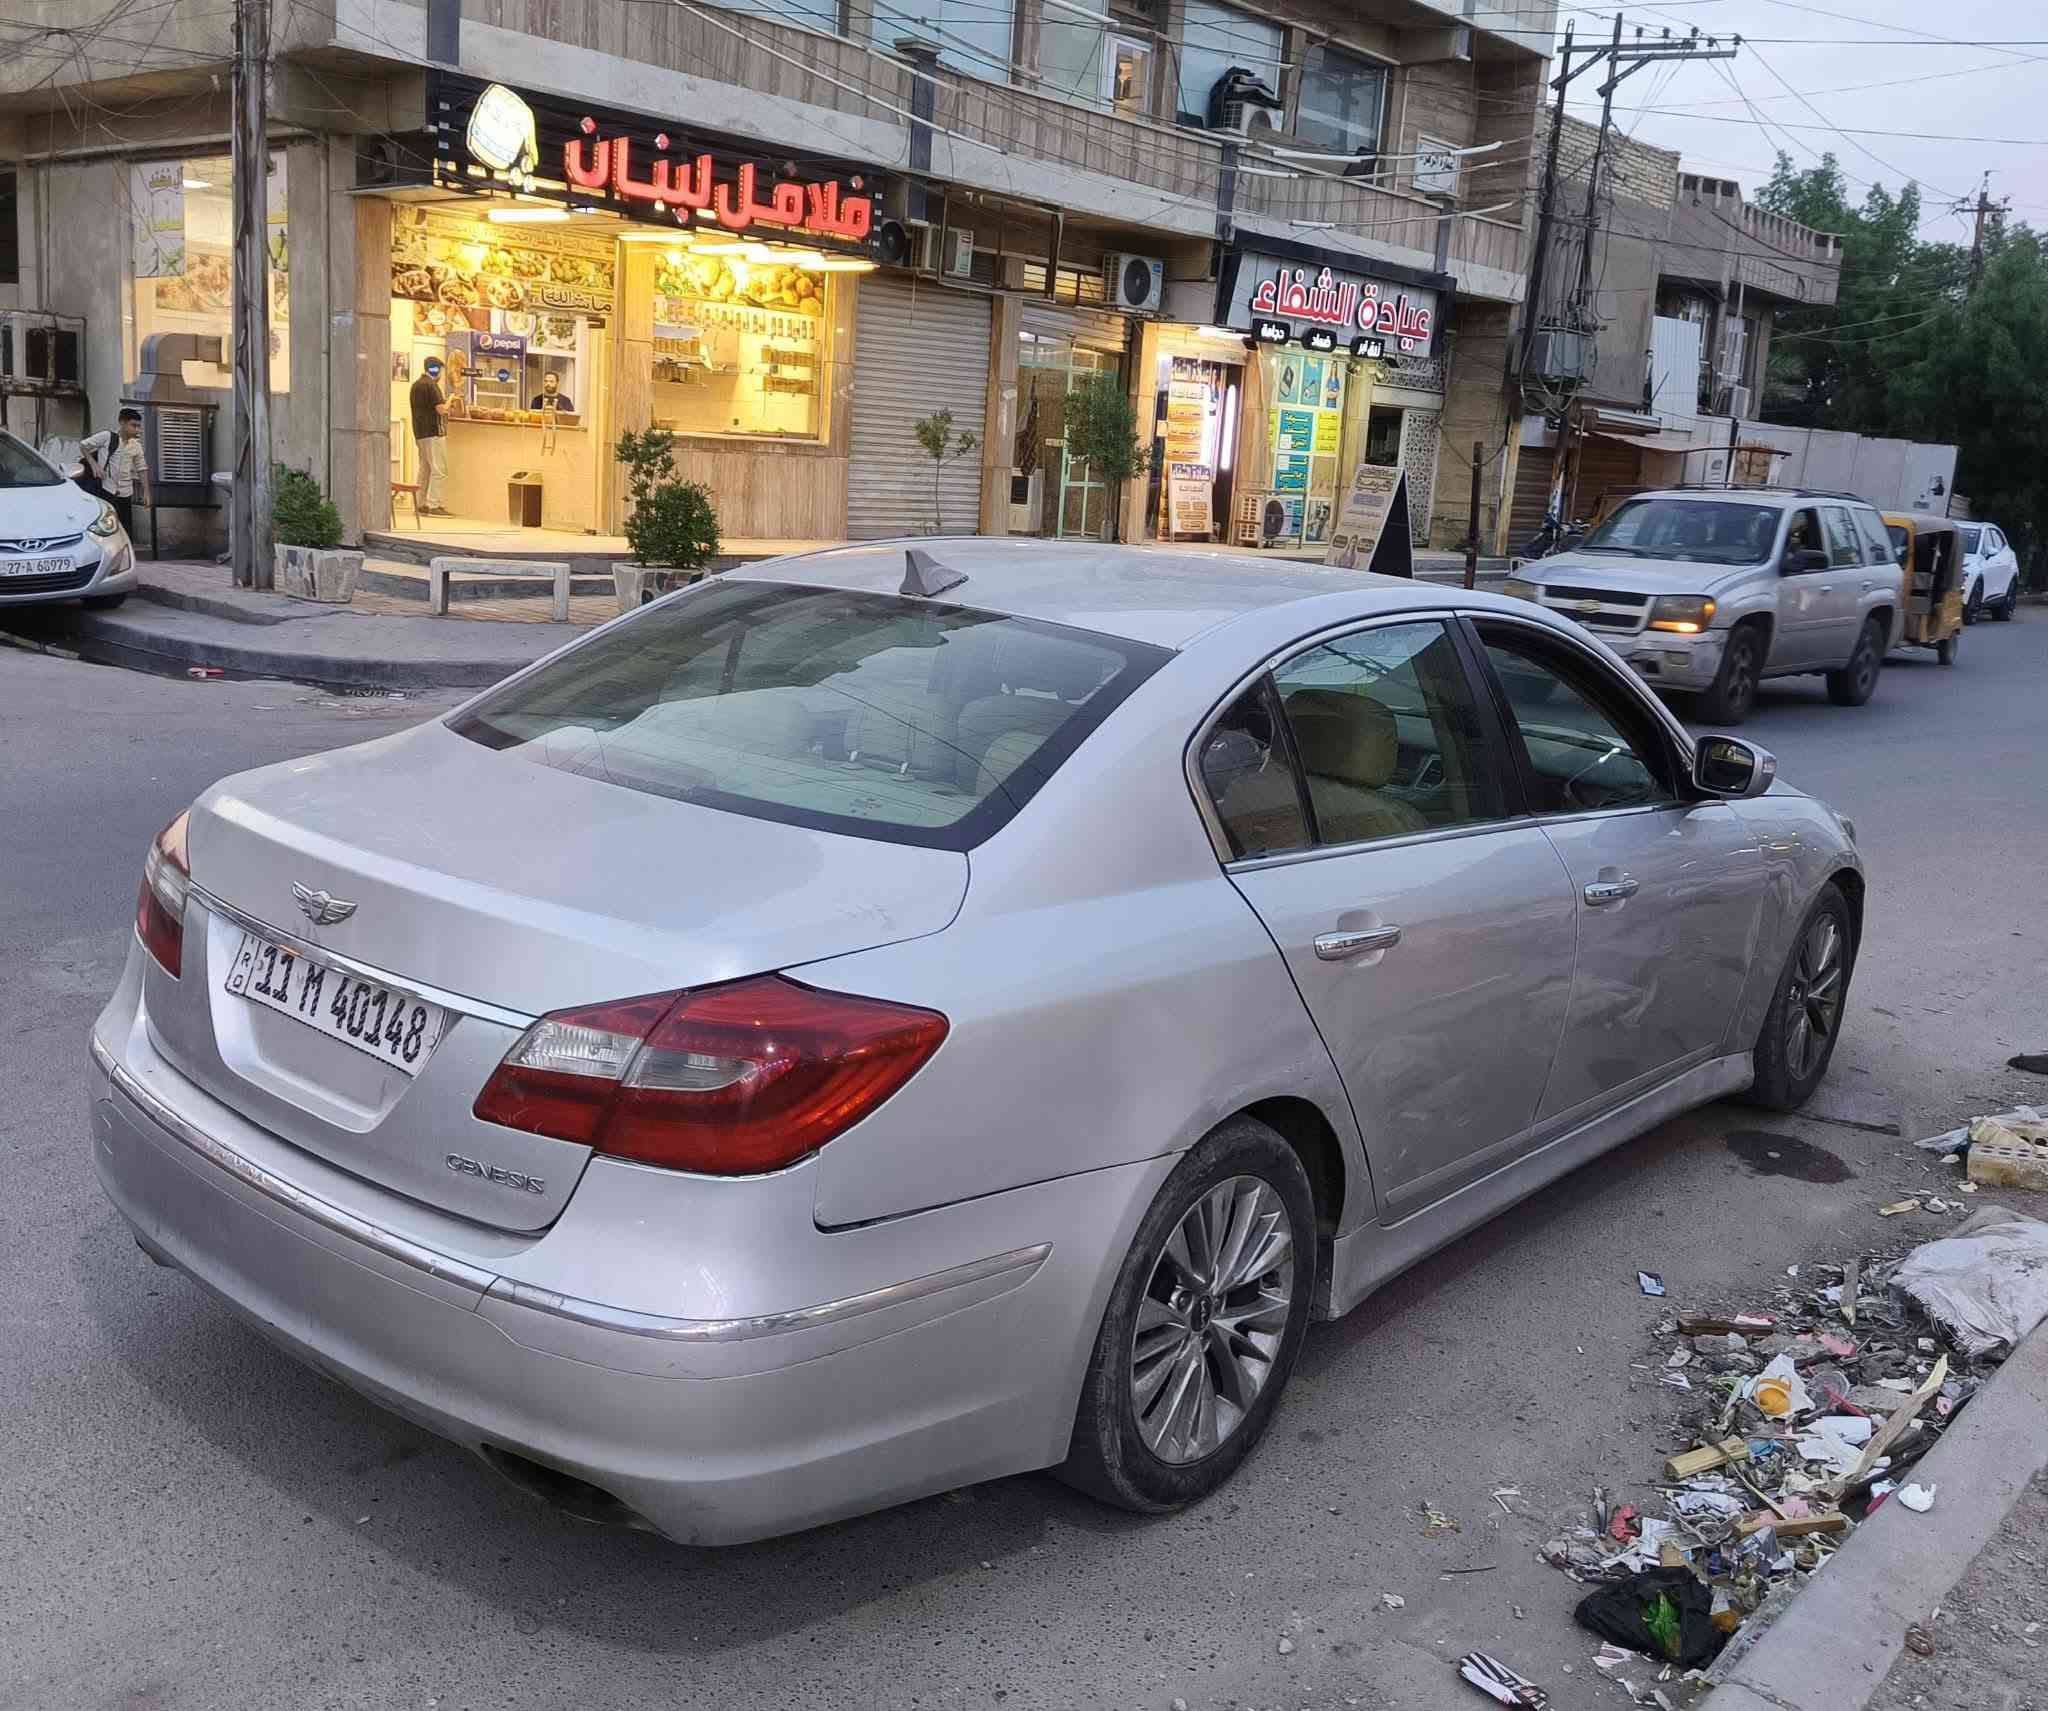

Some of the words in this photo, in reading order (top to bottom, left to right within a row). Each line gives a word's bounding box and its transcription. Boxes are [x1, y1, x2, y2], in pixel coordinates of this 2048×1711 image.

[564, 116, 712, 225] لبنان
[714, 160, 871, 238] فلافل
[1253, 267, 1357, 327] الشفاء
[1358, 283, 1431, 350] عيادة
[493, 339, 520, 350] pepsi
[1261, 324, 1285, 340] حجامة
[1312, 333, 1331, 348] ضماد
[255, 946, 294, 1003] 11
[299, 963, 325, 1017] M
[331, 977, 427, 1063] 40148
[446, 1153, 544, 1194] GENESIS
